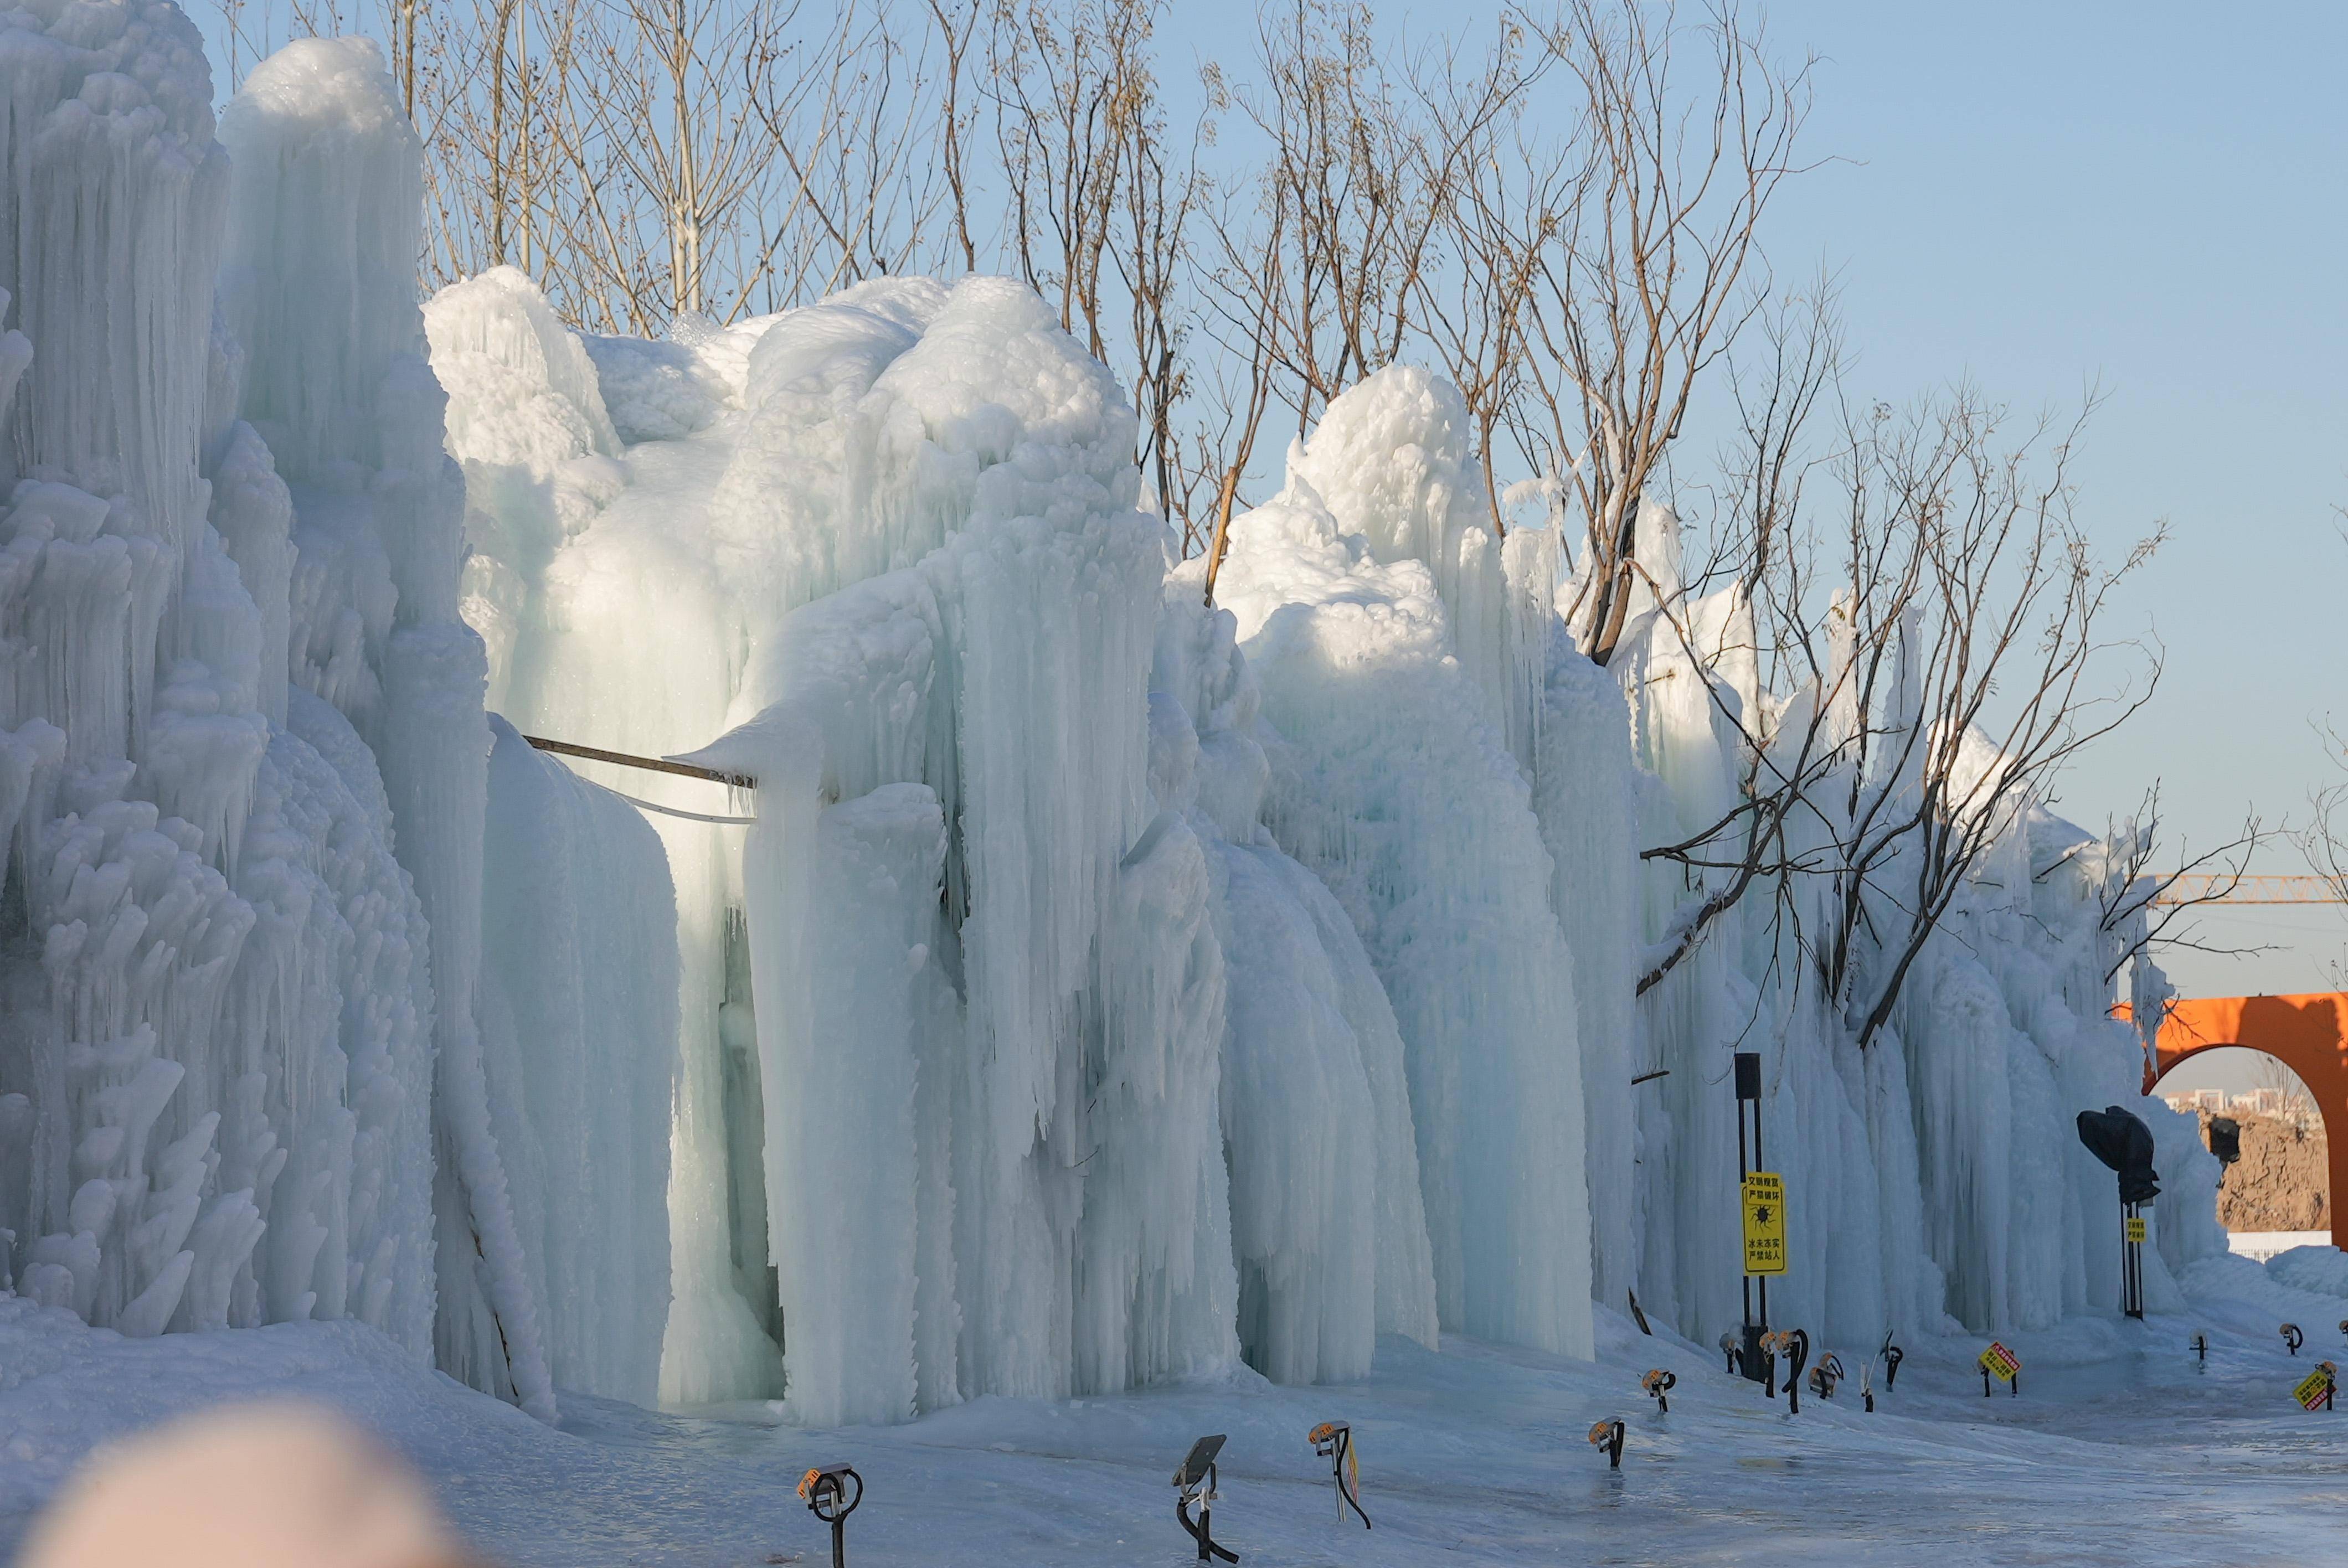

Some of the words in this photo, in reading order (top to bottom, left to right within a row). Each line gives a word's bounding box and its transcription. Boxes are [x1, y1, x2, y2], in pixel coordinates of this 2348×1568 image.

[1748, 1238, 1779, 1249] 冰未冻实
[1749, 1250, 1780, 1261] 严禁站人
